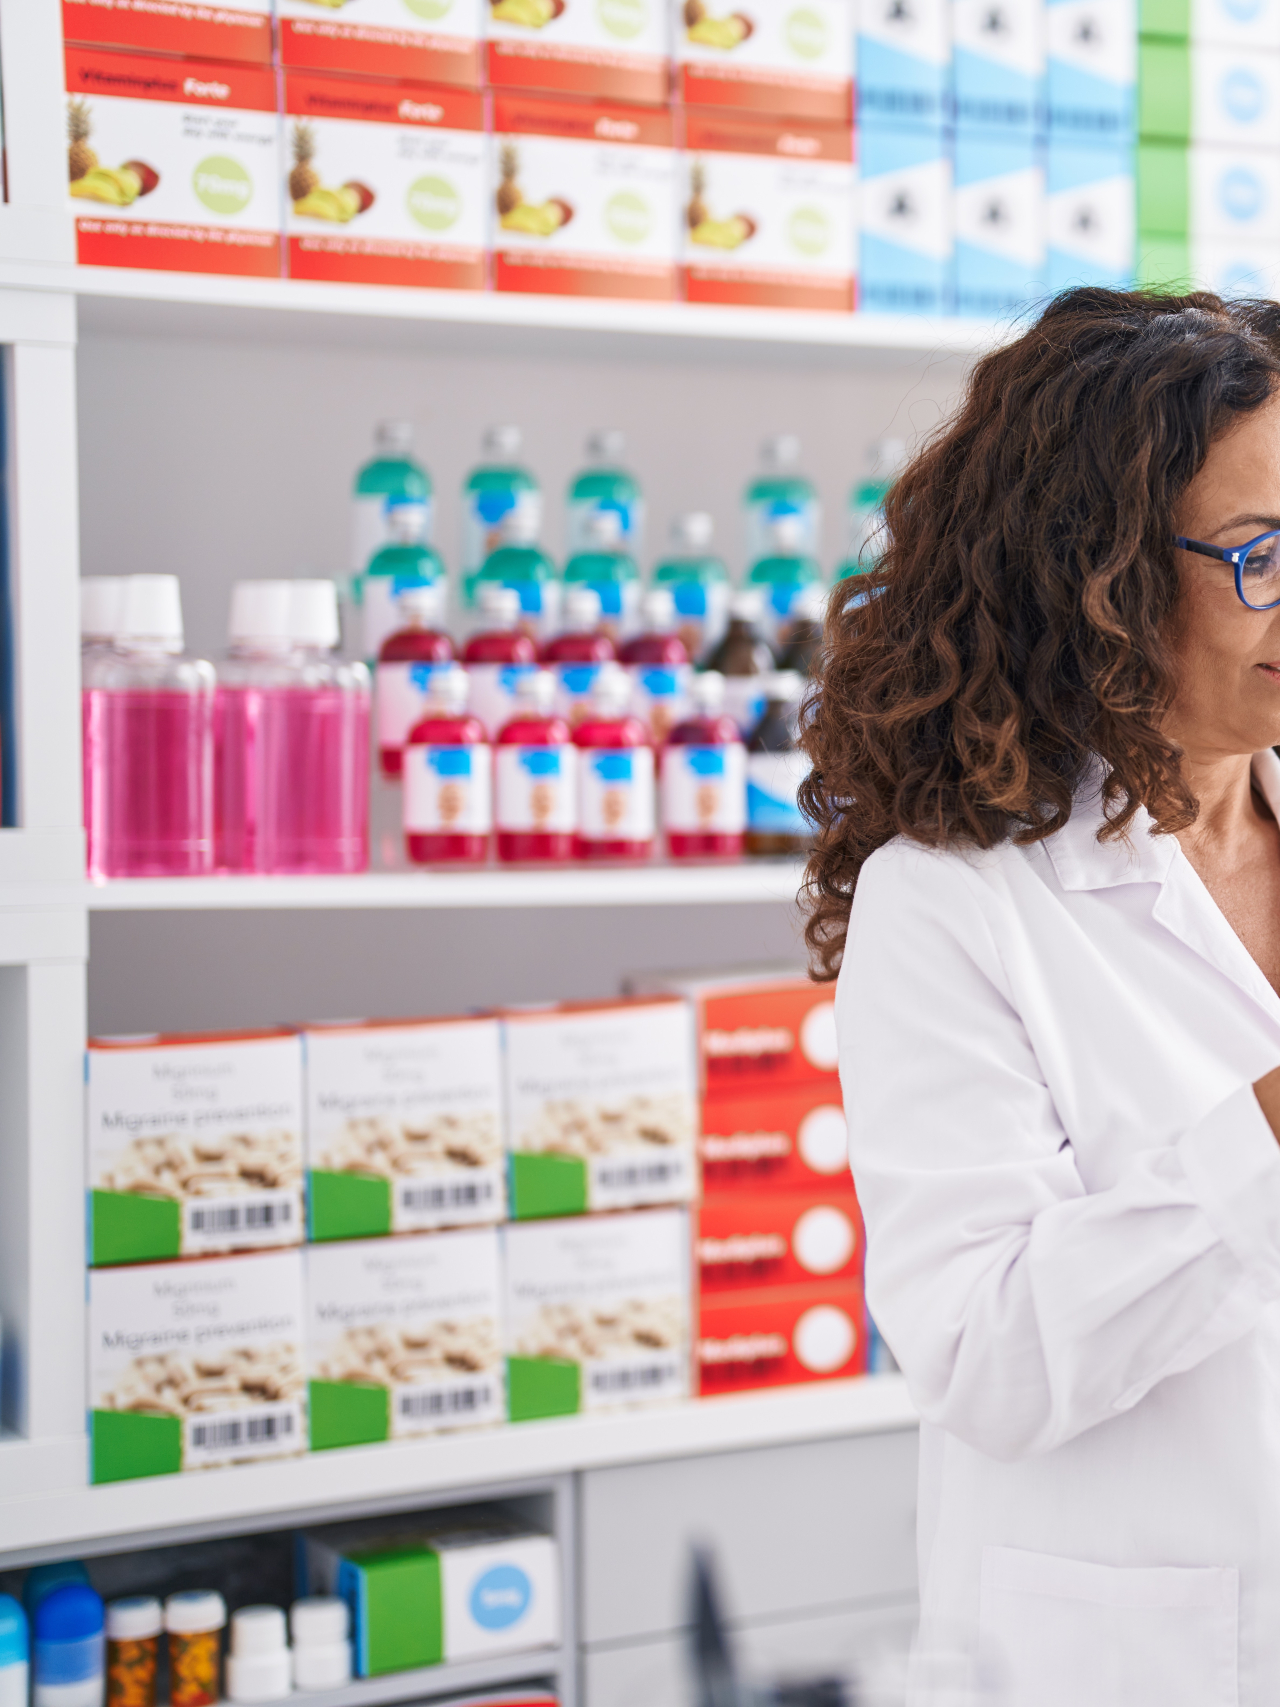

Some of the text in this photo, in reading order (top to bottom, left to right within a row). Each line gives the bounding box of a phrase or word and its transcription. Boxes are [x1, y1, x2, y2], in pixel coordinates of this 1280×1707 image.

[183, 77, 231, 100] Forte
[398, 99, 445, 123] Forte
[102, 1101, 291, 1136] Migraine prevention
[103, 1315, 294, 1354] Migraine prevention
